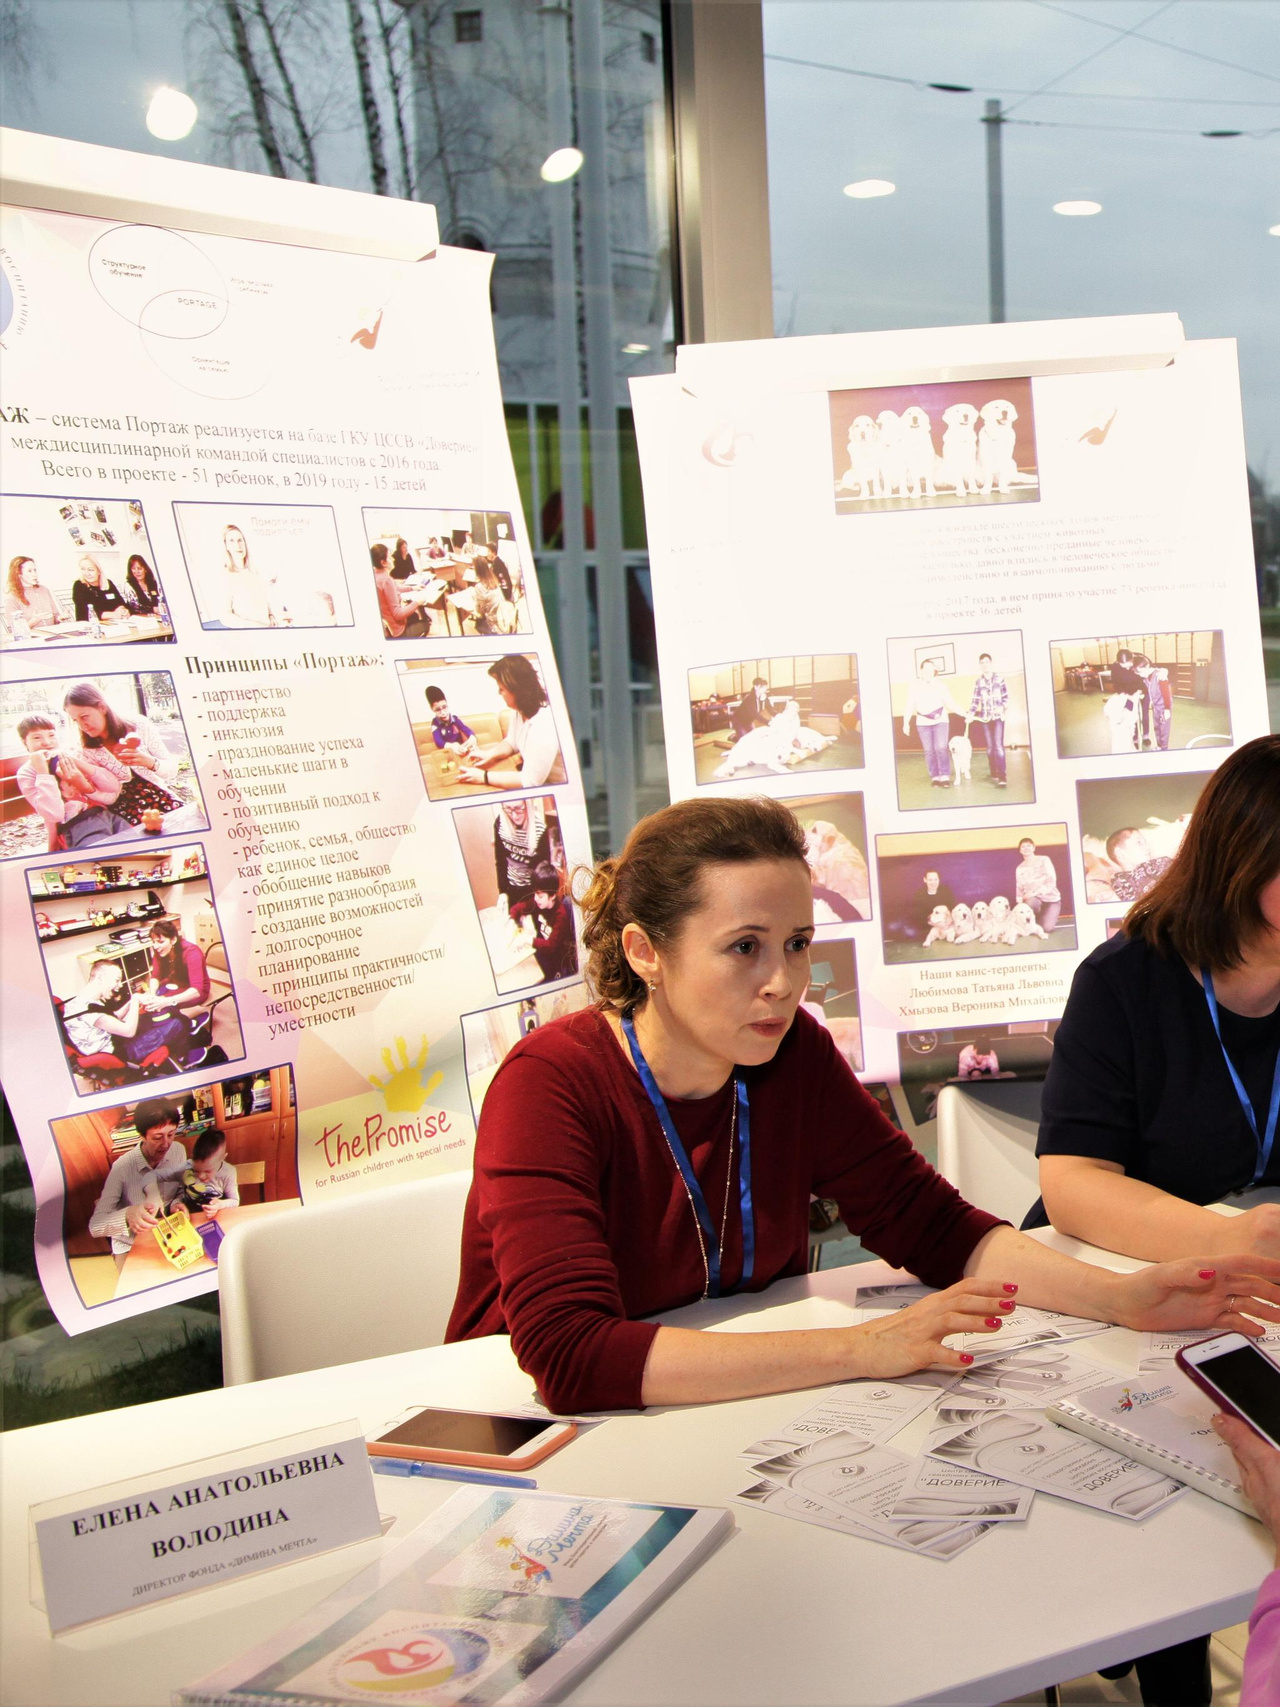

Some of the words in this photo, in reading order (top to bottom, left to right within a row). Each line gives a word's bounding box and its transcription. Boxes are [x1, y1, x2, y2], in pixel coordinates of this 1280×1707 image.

[177, 297, 217, 309] PORTAGE
[52, 414, 121, 431] система
[125, 415, 190, 437] Портаж
[195, 422, 283, 442] реализуется
[288, 429, 304, 442] на
[308, 428, 337, 444] базе
[374, 432, 415, 449] ЦССВ
[11, 437, 191, 461] междисциплинарной
[196, 448, 268, 463] командой
[272, 451, 366, 467] специалистов
[369, 458, 376, 468] с
[381, 454, 409, 470] 2016
[41, 460, 92, 478] Всего
[97, 467, 107, 479] в
[112, 467, 177, 484] проекте
[192, 468, 209, 482] 51
[214, 469, 279, 488] ребенок,
[283, 475, 291, 487] в
[295, 472, 327, 488] 2019
[331, 478, 360, 492] году
[374, 475, 388, 490] 15
[392, 479, 427, 492] детей
[1078, 586, 1117, 598] участие
[184, 656, 288, 678] Принципы
[293, 652, 385, 673] «Портаж»:
[202, 686, 291, 705] партнерство
[207, 706, 286, 722] поддержка
[212, 724, 284, 741] инклюзия
[217, 739, 316, 764] празднование
[319, 735, 364, 756] успеха
[222, 759, 299, 780] маленькие
[302, 757, 337, 773] шаги
[341, 756, 349, 768] в
[217, 782, 286, 803] обучении
[233, 796, 319, 819] позитивный
[323, 791, 370, 808] подход
[373, 790, 381, 801] к
[227, 819, 300, 841] обучению
[242, 837, 307, 860] ребенок,
[308, 832, 352, 848] семья,
[355, 822, 417, 842] общество
[237, 863, 263, 879] как
[266, 854, 317, 874] единое
[320, 850, 359, 866] целое
[252, 871, 333, 897] обобщение
[336, 862, 391, 883] навыков
[257, 894, 324, 919] принятие
[328, 877, 417, 906] разнообразия
[261, 912, 326, 936] создание
[329, 892, 424, 923] возможностей
[265, 926, 363, 958] долгосрочное
[258, 945, 361, 977] планирование
[272, 967, 349, 997] принципы
[352, 943, 446, 980] практичности/
[920, 970, 952, 980] Наши
[265, 968, 415, 1017] непосредственности/
[909, 987, 969, 999] Любимова
[972, 982, 1015, 993] Татьяна
[1018, 979, 1064, 990] Львовна
[268, 1005, 357, 1041] уместности
[899, 1006, 949, 1017] Хмызова
[952, 1001, 1005, 1015] Вероника
[315, 1178, 328, 1188] for
[330, 1169, 361, 1184] Russian
[363, 1159, 394, 1174] children
[396, 1152, 414, 1164] with
[416, 1145, 442, 1160] special
[443, 1138, 466, 1150] needs
[71, 1500, 161, 1537] ЕЛЕНА
[168, 1451, 345, 1511] АНАТОЛЬЕВНА
[151, 1507, 290, 1558] ВОЛОДИНА
[132, 1573, 187, 1597] ДИРЕКТОР
[188, 1563, 226, 1578] ФОНДА
[228, 1547, 276, 1569] «ДИМИНА
[279, 1536, 317, 1553] МЕЧТА»
